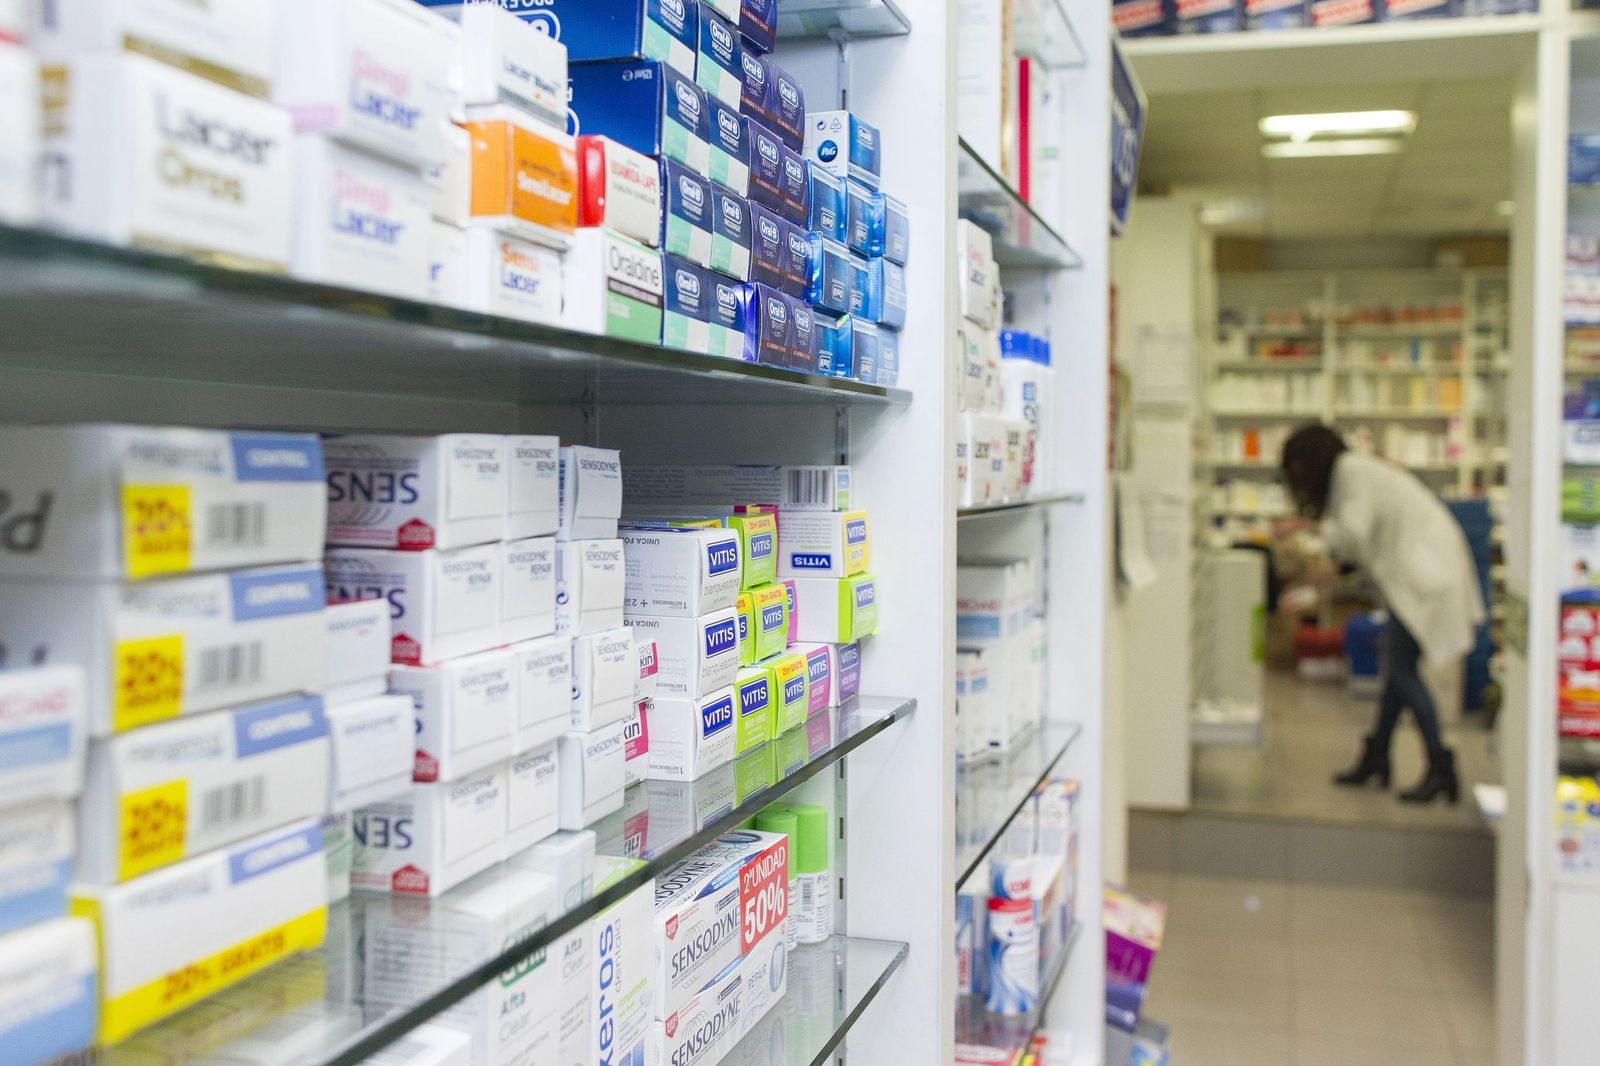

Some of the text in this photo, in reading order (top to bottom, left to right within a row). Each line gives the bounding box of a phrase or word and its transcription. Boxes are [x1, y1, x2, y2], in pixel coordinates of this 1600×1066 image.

[711, 22, 732, 48] Oral-B
[154, 91, 274, 165] Lacer
[719, 113, 739, 138] Oral-B
[758, 138, 778, 162] Oral-B
[723, 202, 741, 222] Oral-B
[760, 220, 779, 242] Oral-B
[609, 245, 660, 288] Oraldine
[579, 458, 619, 473] SENSODYNE
[847, 525, 866, 540] VITIS
[751, 539, 771, 553] VITIS
[709, 548, 736, 567] VITIS
[793, 556, 830, 566] VITIS
[856, 587, 874, 603] VITIS
[763, 610, 783, 625] VITIS
[707, 627, 735, 648] VITIS
[840, 648, 858, 664] VITIS
[808, 659, 827, 677] VITIS
[741, 687, 767, 708] VITIS
[785, 681, 804, 699] VITIS
[703, 703, 732, 729] VITIS
[744, 875, 785, 945] 50%
[671, 905, 741, 979] SENSODYNE
[671, 995, 741, 1066] SENSODYNE
